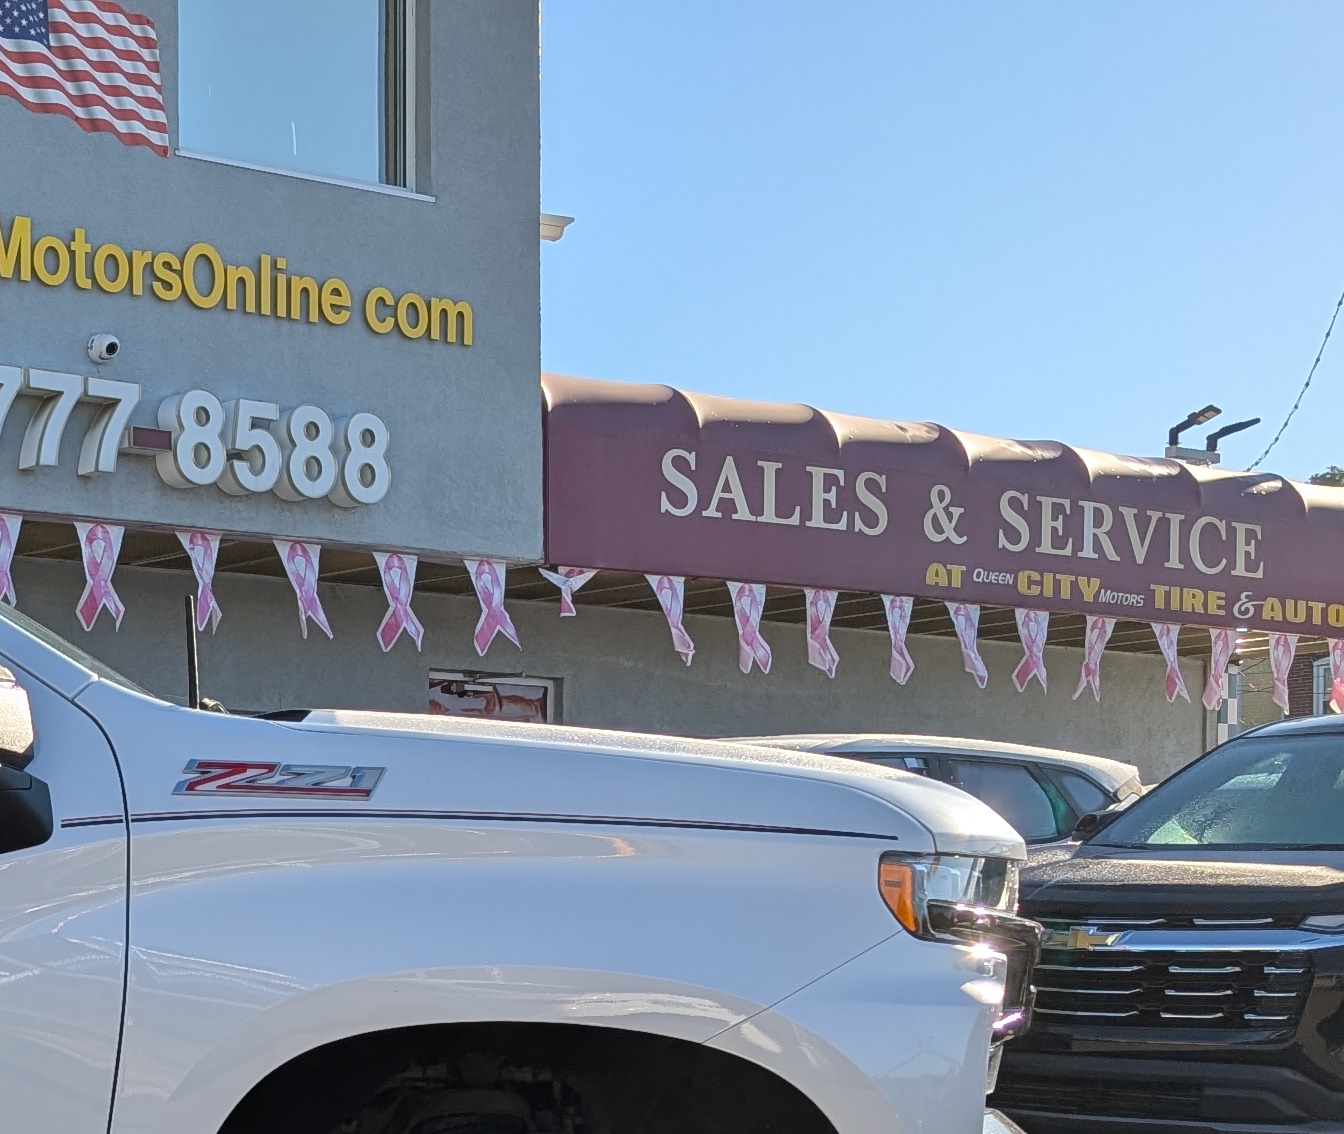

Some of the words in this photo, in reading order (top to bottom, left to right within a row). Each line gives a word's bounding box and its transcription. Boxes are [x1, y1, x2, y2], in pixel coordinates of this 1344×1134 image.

[660, 448, 889, 537] SALES
[923, 484, 968, 545] &
[998, 490, 1265, 578] SERVICE
[925, 562, 966, 588] AT
[973, 568, 1014, 585] QUEEN
[1017, 570, 1100, 602] CITY
[1099, 588, 1145, 607] MOTORS
[1150, 583, 1226, 616] TIRE
[1233, 592, 1264, 619] &
[1262, 597, 1344, 628] AUTO
[172, 759, 387, 801] Z71
